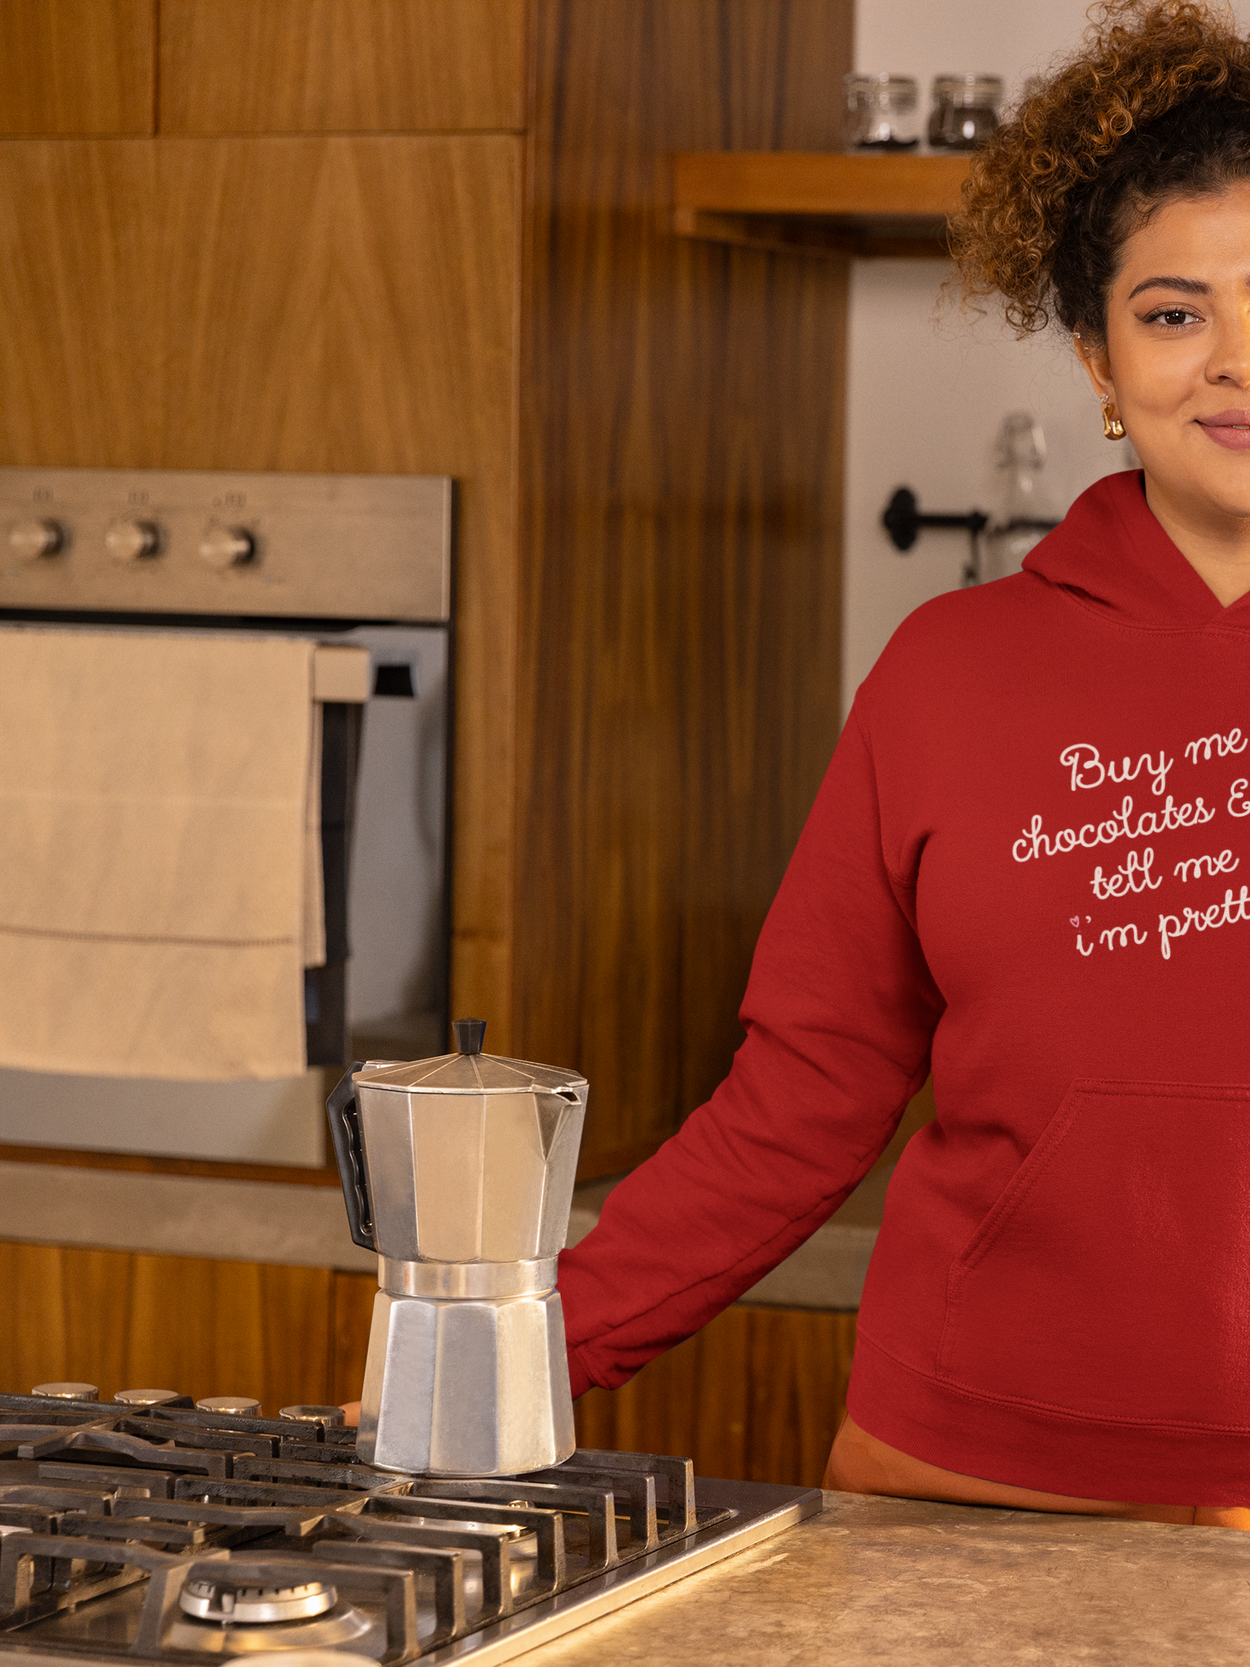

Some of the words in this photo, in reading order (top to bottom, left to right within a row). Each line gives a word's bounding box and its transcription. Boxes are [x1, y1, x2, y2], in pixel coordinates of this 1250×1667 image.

[1060, 743, 1174, 796] Buy
[1184, 728, 1249, 764] me
[1012, 795, 1216, 862] chocolates
[1090, 847, 1163, 900] tell
[1173, 849, 1240, 882] me
